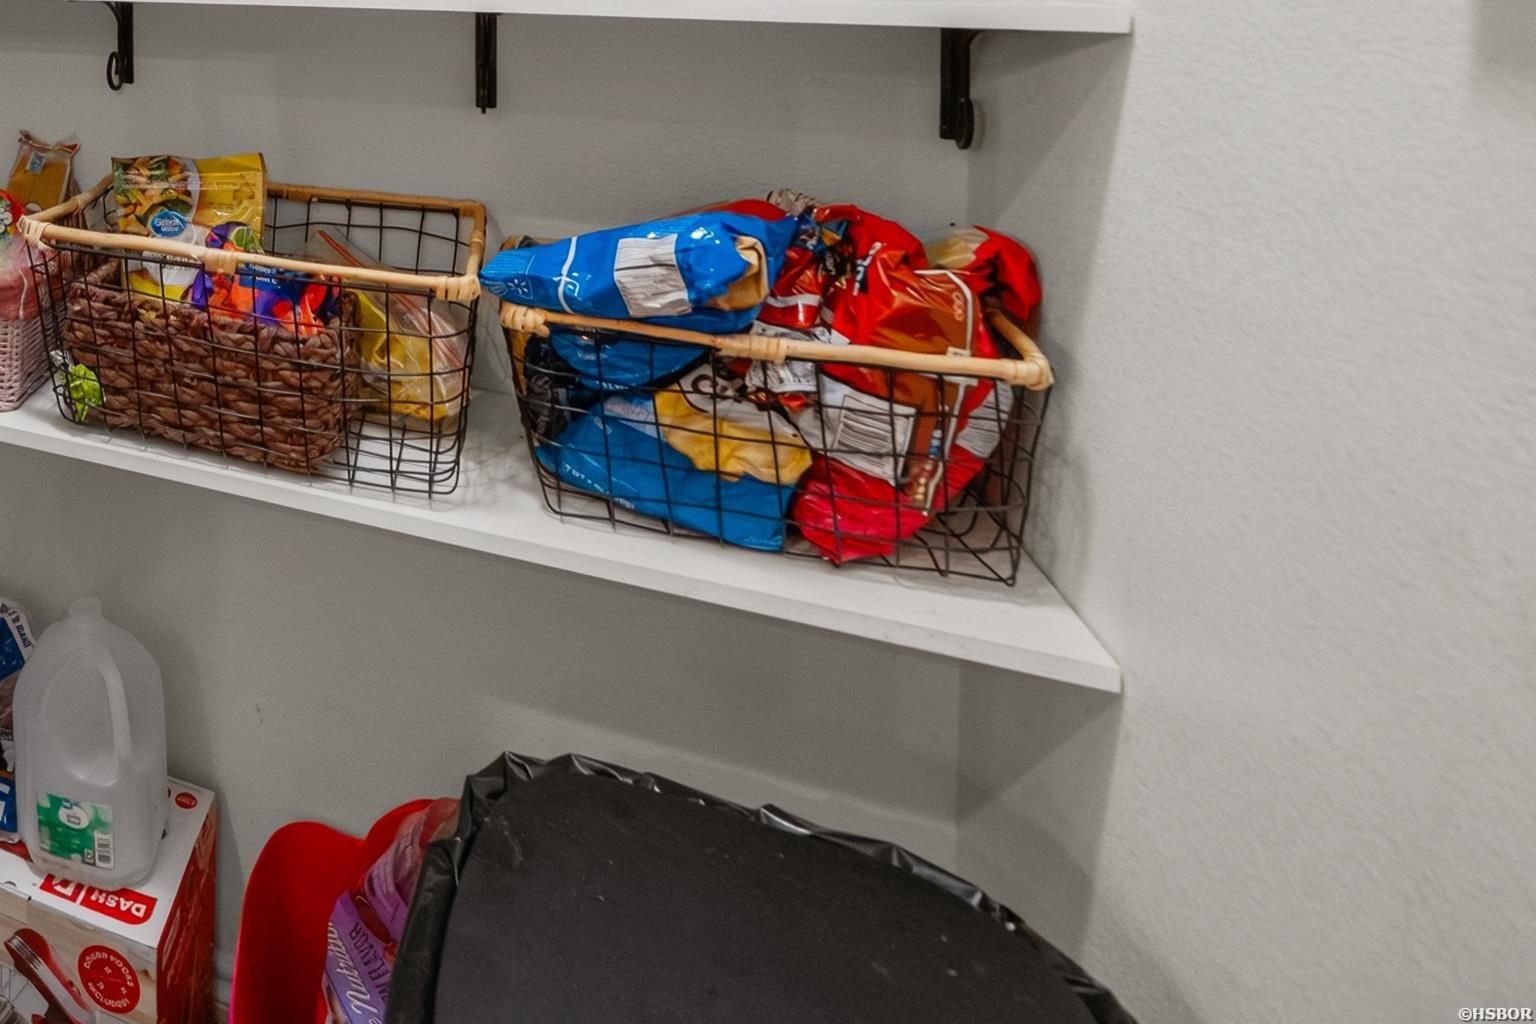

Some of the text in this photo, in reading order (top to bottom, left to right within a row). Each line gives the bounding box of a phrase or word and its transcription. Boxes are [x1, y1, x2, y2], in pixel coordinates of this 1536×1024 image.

[154, 217, 180, 227] Great
[160, 224, 180, 234] Value
[89, 890, 148, 918] DASH
[349, 921, 390, 982] FLAVOR
